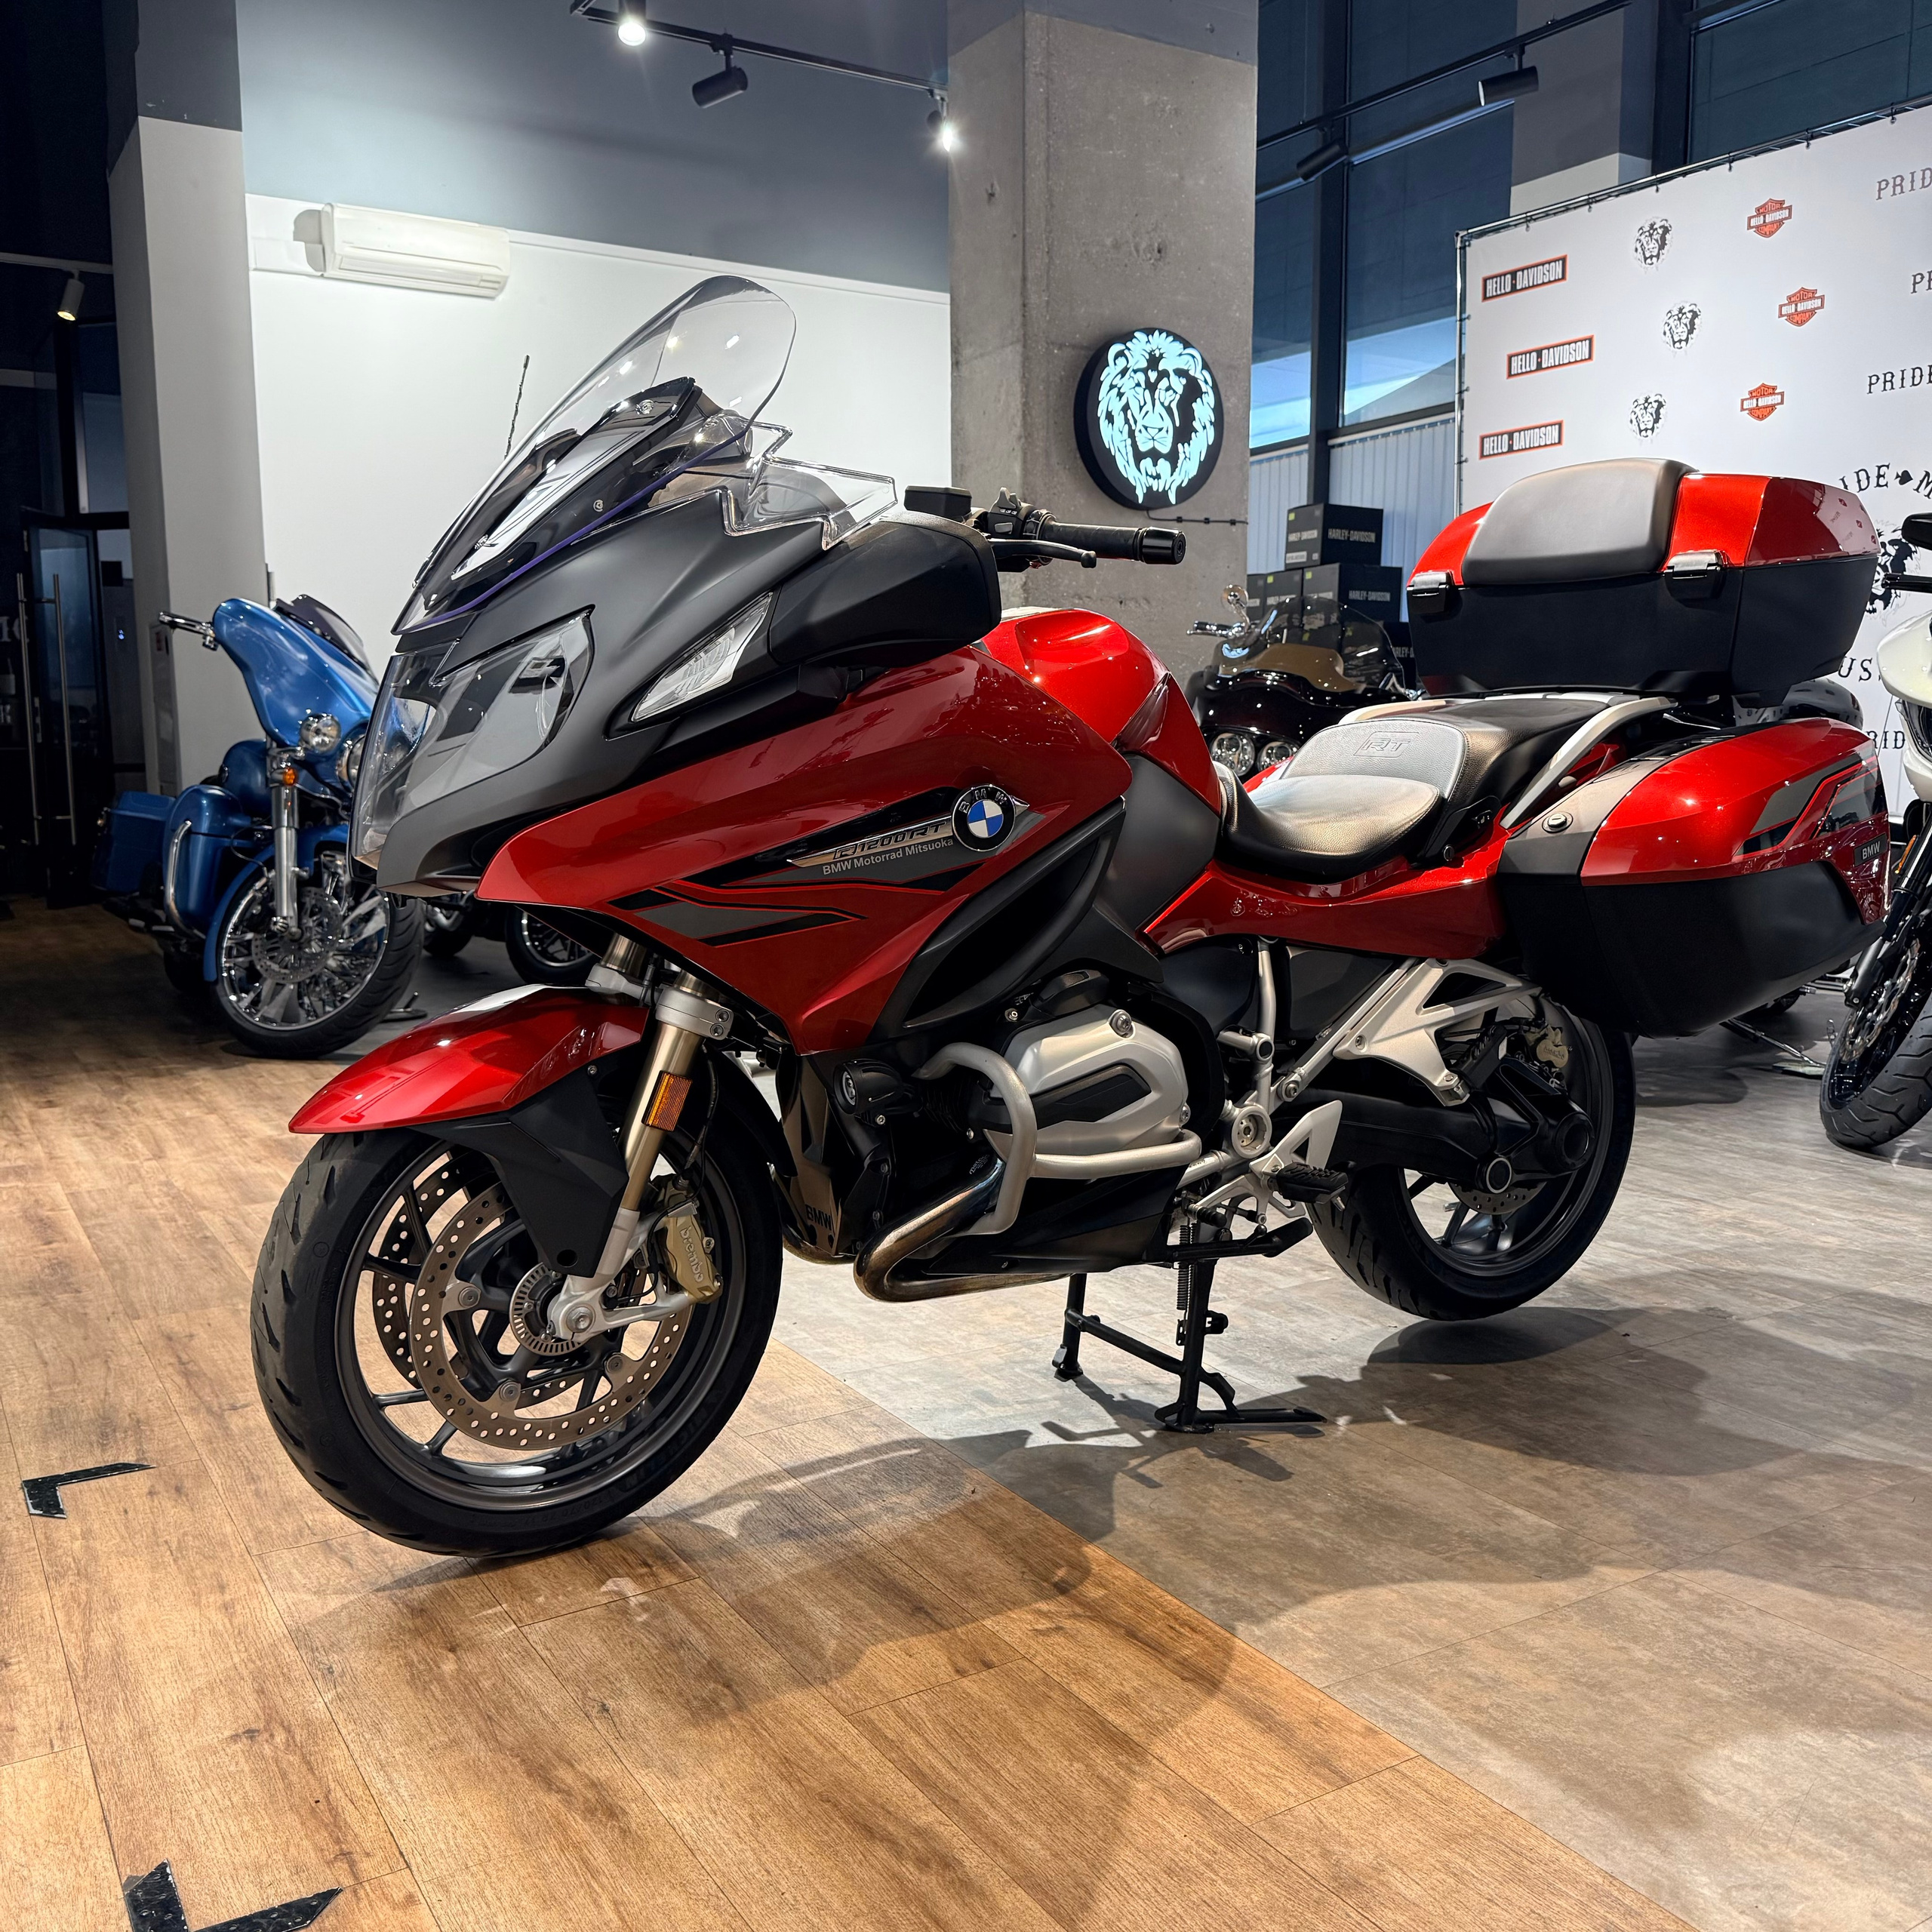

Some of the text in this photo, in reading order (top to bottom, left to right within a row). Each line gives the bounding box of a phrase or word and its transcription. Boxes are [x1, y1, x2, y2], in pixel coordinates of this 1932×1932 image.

[1486, 260, 1562, 297] HELLO DAVIDSON
[1791, 291, 1813, 302] MOTOR
[1511, 340, 1589, 375] HELLO DAVIDSON
[1752, 386, 1774, 396] MOTOR
[1483, 424, 1558, 456] HELLO DAVIDSON
[1328, 528, 1376, 543] HARLEY-DAVIDSON
[1362, 738, 1411, 752] RT
[958, 788, 1008, 814] BMW
[823, 838, 954, 875] BMW Motorrad Mitsuoka
[1862, 841, 1880, 860] BMW
[804, 1204, 832, 1231] BMW
[679, 1226, 703, 1282] brembo
